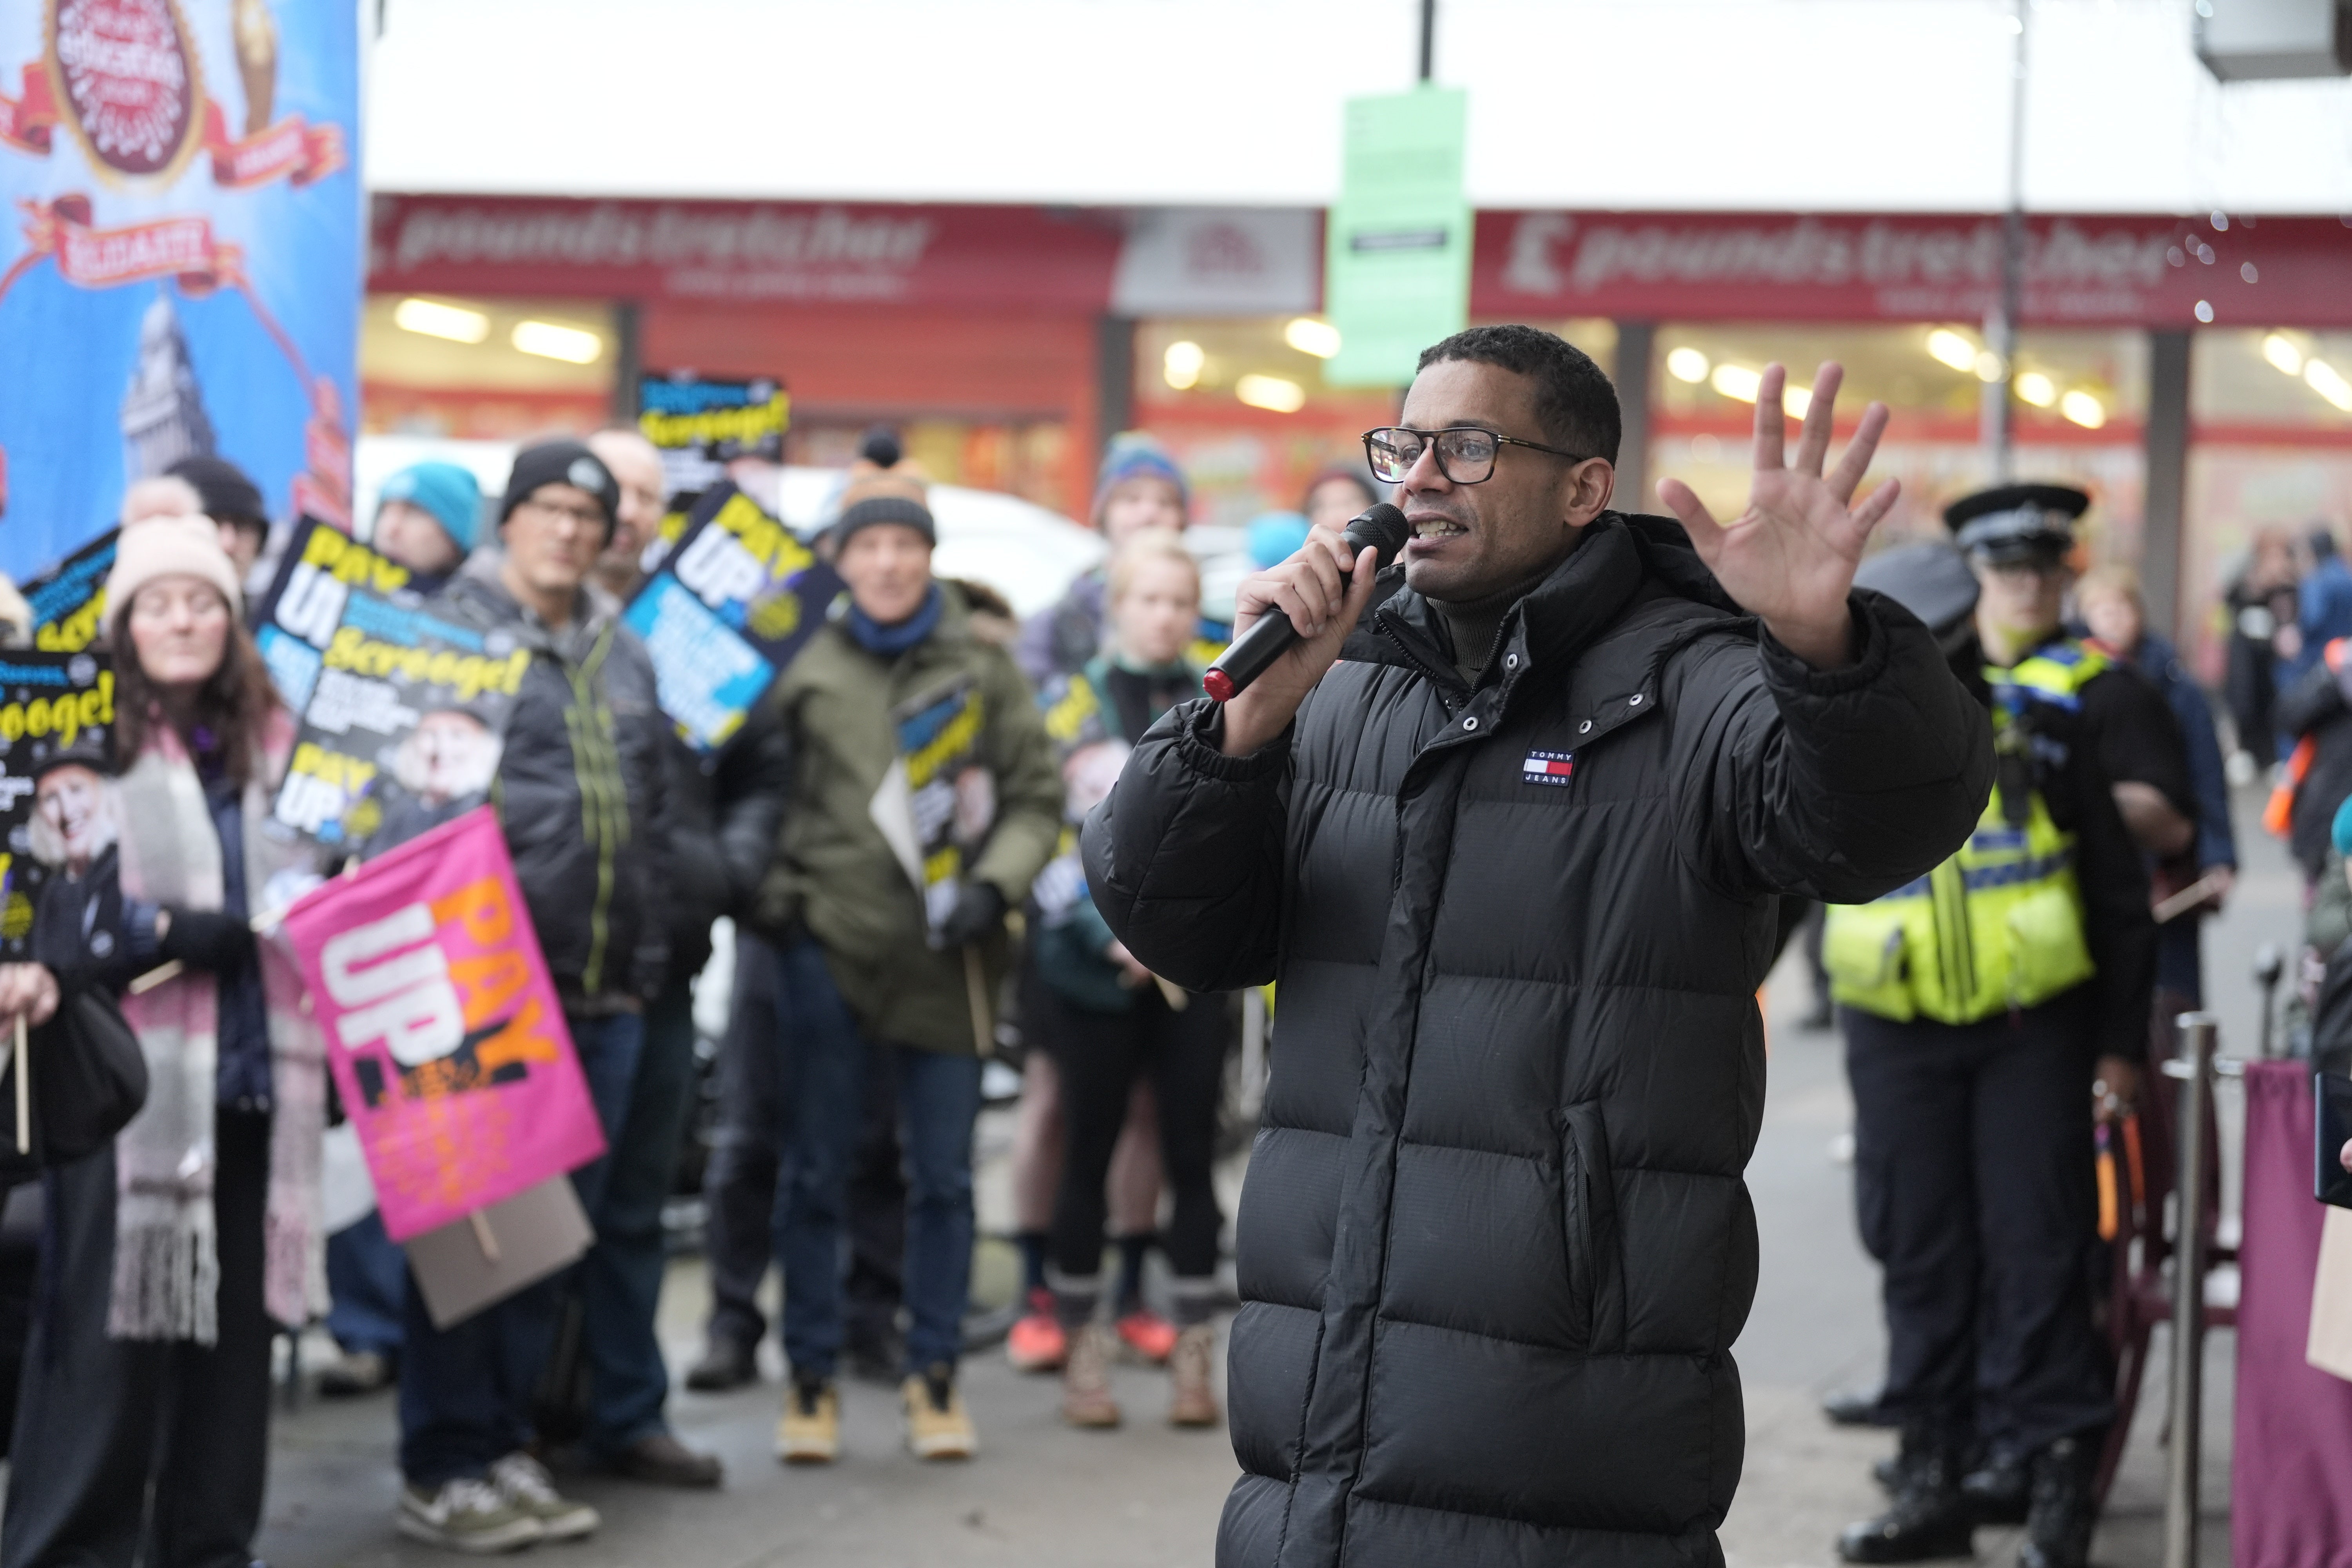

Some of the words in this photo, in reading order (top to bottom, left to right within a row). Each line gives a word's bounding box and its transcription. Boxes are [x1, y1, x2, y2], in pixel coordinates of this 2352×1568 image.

[323, 625, 531, 700] Scrooge!
[1531, 751, 1572, 760] TOMMY
[1525, 774, 1566, 784] JEANS
